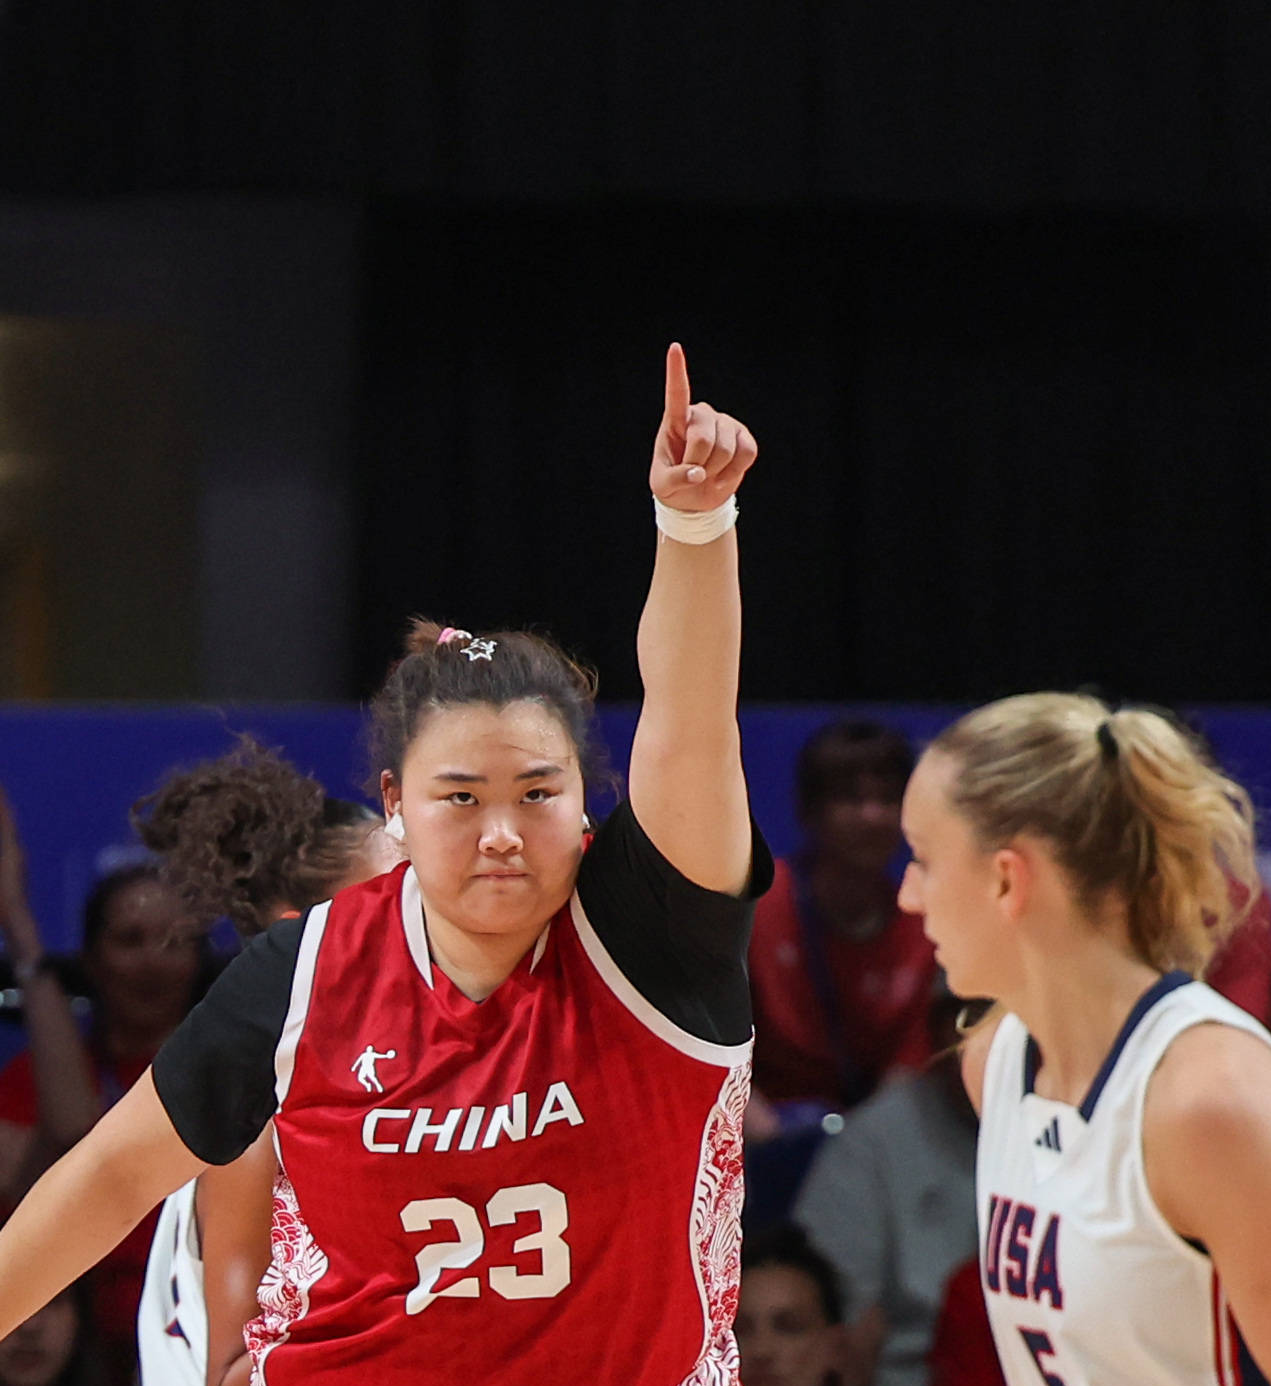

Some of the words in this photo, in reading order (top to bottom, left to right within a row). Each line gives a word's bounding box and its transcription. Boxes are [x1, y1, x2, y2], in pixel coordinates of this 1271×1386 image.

[362, 1081, 585, 1154] CHINA
[400, 1182, 572, 1316] 23
[985, 1193, 1065, 1311] USA
